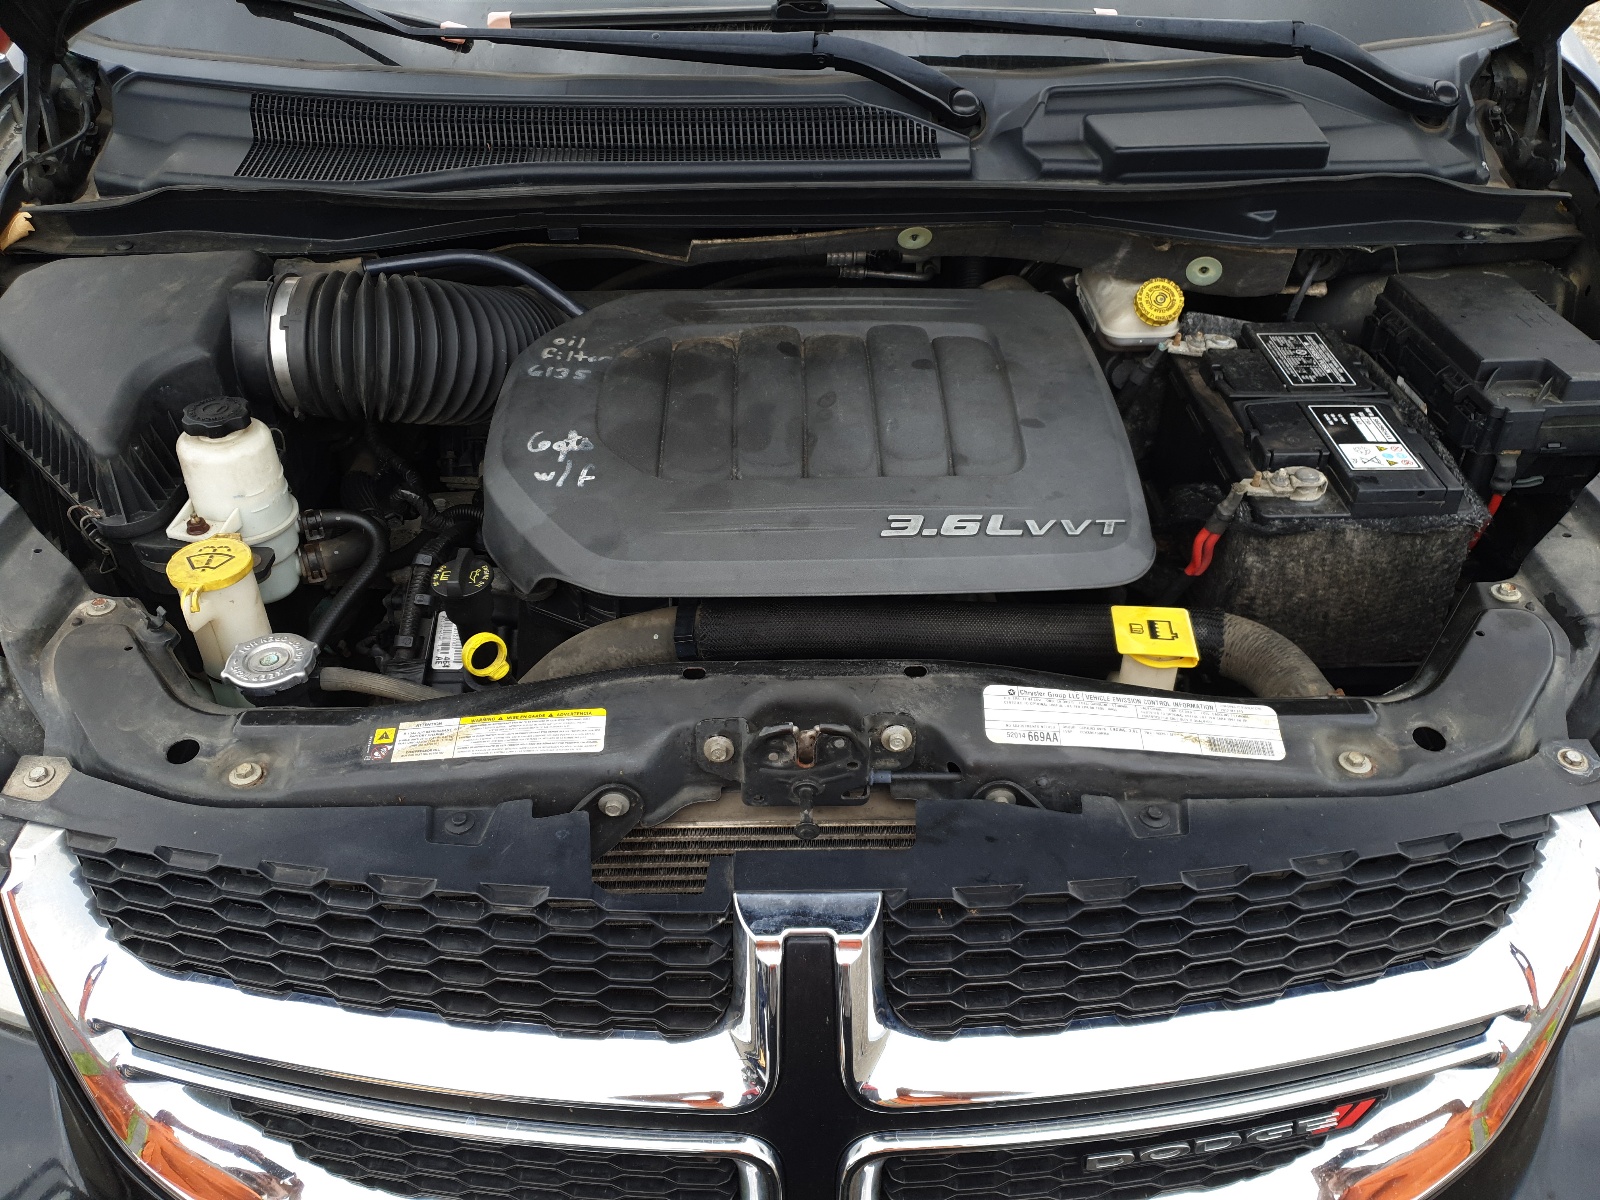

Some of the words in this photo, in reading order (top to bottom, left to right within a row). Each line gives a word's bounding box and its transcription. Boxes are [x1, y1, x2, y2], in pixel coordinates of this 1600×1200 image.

[1019, 689, 1046, 697] Chrysler
[1048, 691, 1067, 700] Group
[1068, 692, 1080, 700] LLC
[1085, 694, 1111, 702] VEHICLE
[1112, 696, 1142, 704] EMISSION
[1143, 698, 1171, 707] CONTROL
[1172, 701, 1214, 710] INFORMATION
[1027, 731, 1059, 743] 669AA
[1084, 1110, 1340, 1171] DODGE
